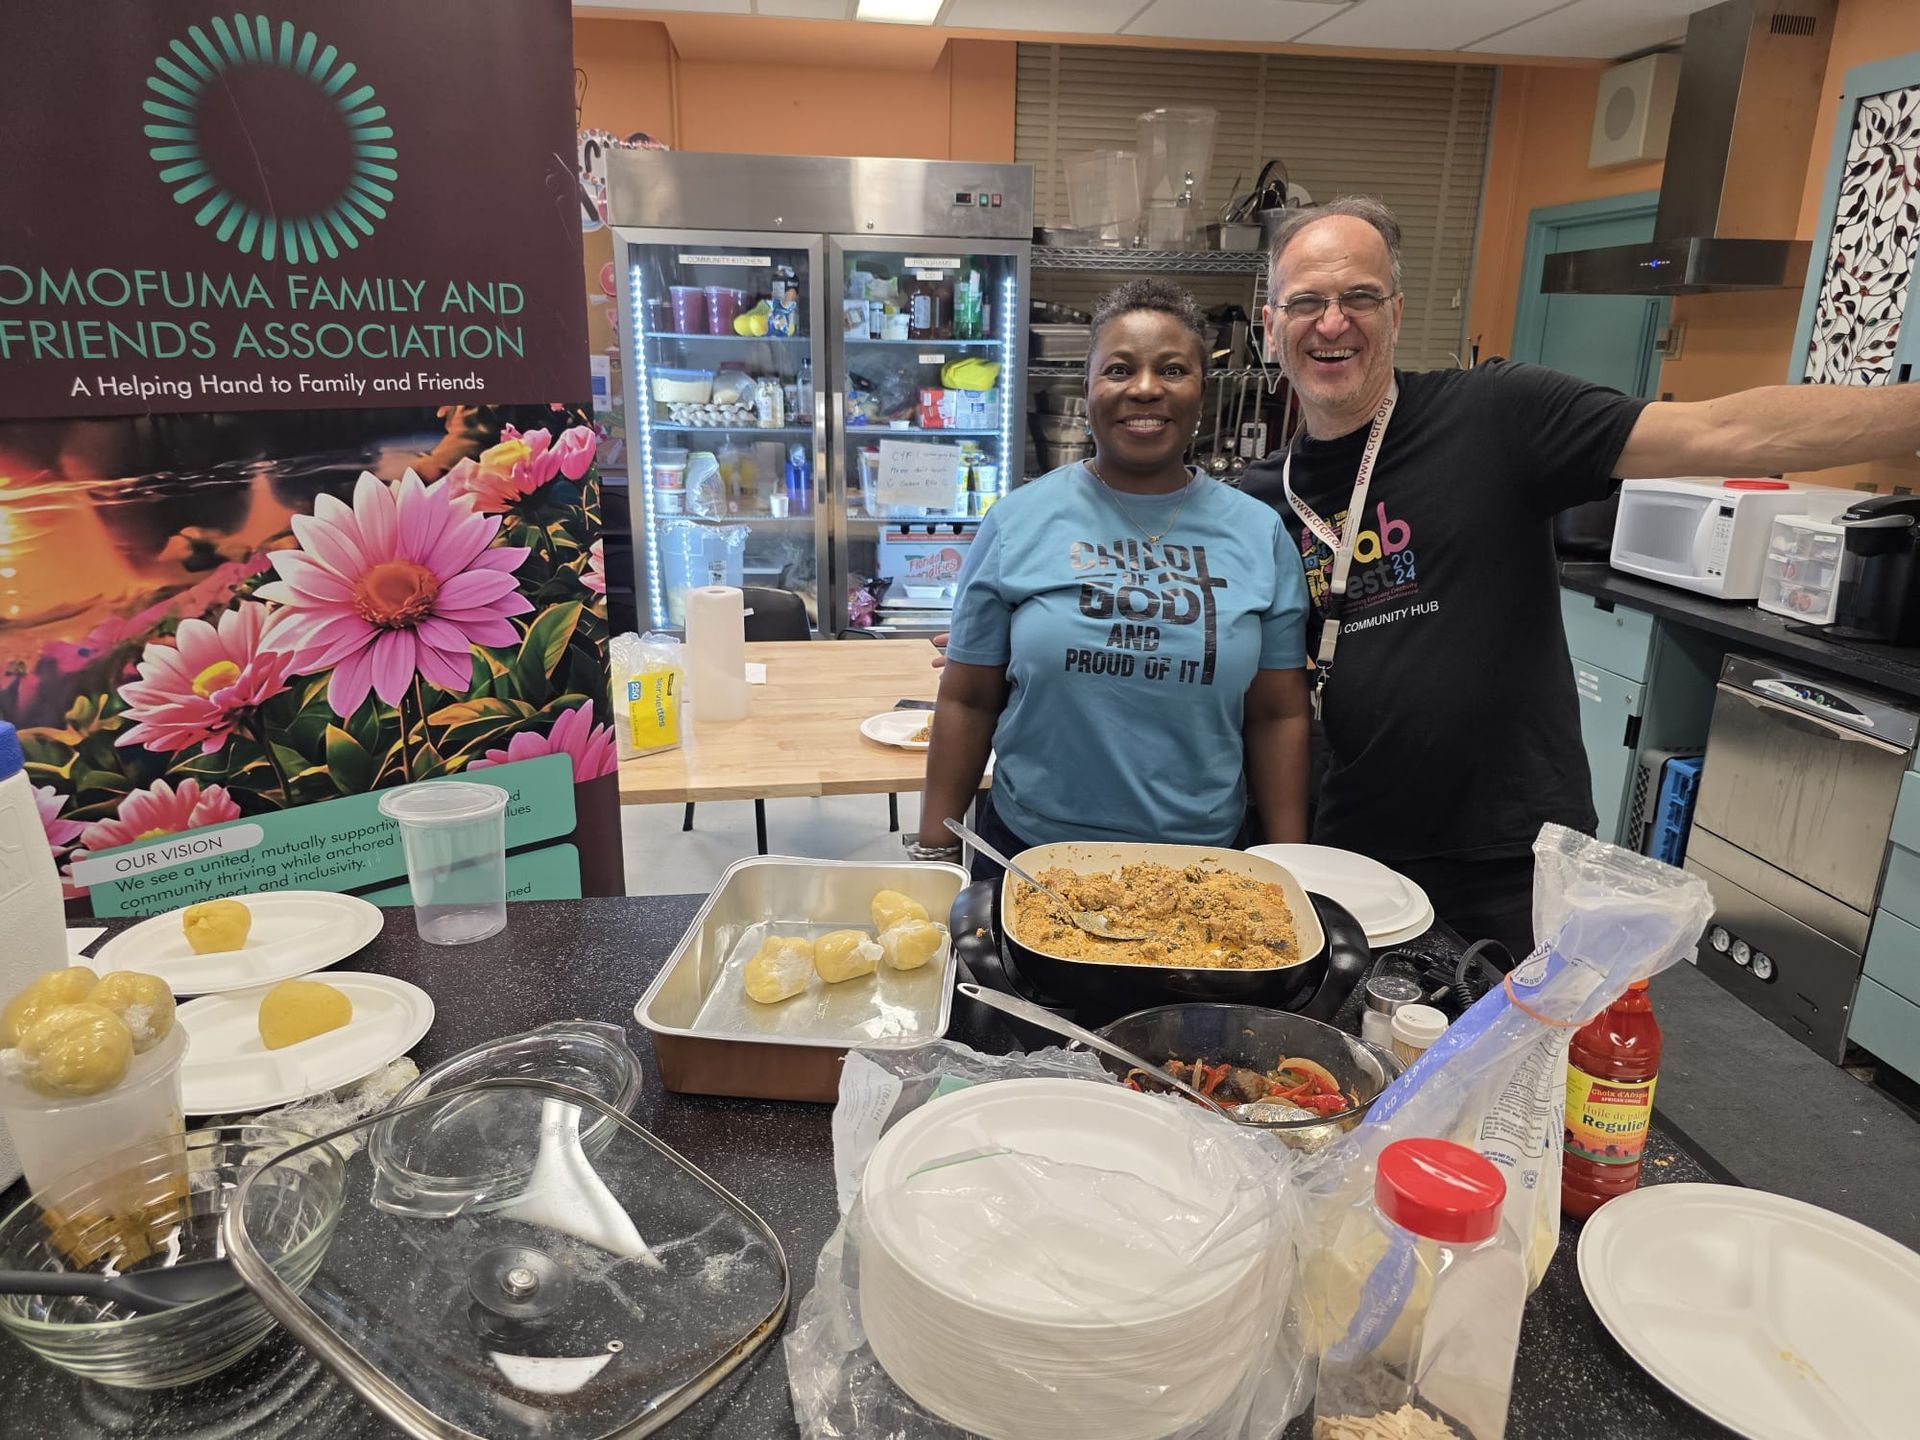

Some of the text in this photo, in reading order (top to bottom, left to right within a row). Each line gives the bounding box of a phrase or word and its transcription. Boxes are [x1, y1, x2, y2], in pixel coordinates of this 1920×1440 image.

[0, 265, 525, 314] OMOFUMA FAMILY AND
[0, 320, 525, 359] FRIENDS ASSOCIATION
[71, 371, 485, 400] A Helping Hand to Family and Friends
[1357, 397, 1393, 486] www.crcrr.org
[1353, 502, 1411, 563] ab
[1070, 538, 1191, 571] CHILD
[1391, 550, 1415, 570] 20
[1122, 570, 1149, 586] OF
[1346, 560, 1394, 599] est
[1394, 566, 1416, 585] 24
[1079, 580, 1201, 626] GOD
[1344, 607, 1409, 634] COMMUNITY
[1411, 600, 1440, 617] HUB
[1106, 622, 1160, 651] AND
[1064, 647, 1200, 683] PROUD OF IT
[631, 682, 640, 699] 250
[115, 836, 223, 872] OUR VISION
[115, 880, 145, 893] We
[151, 870, 179, 886] see
[184, 866, 195, 878] a
[200, 850, 256, 873] united,
[262, 835, 327, 859] mutually
[120, 878, 212, 911] community
[217, 863, 277, 888] thriving
[281, 852, 321, 871] while
[326, 834, 394, 861] anchored
[258, 874, 289, 893] and
[294, 858, 366, 884] inclusivity.
[1591, 1088, 1615, 1097] Choix
[1583, 1103, 1611, 1119] Huile
[1613, 1111, 1626, 1121] de
